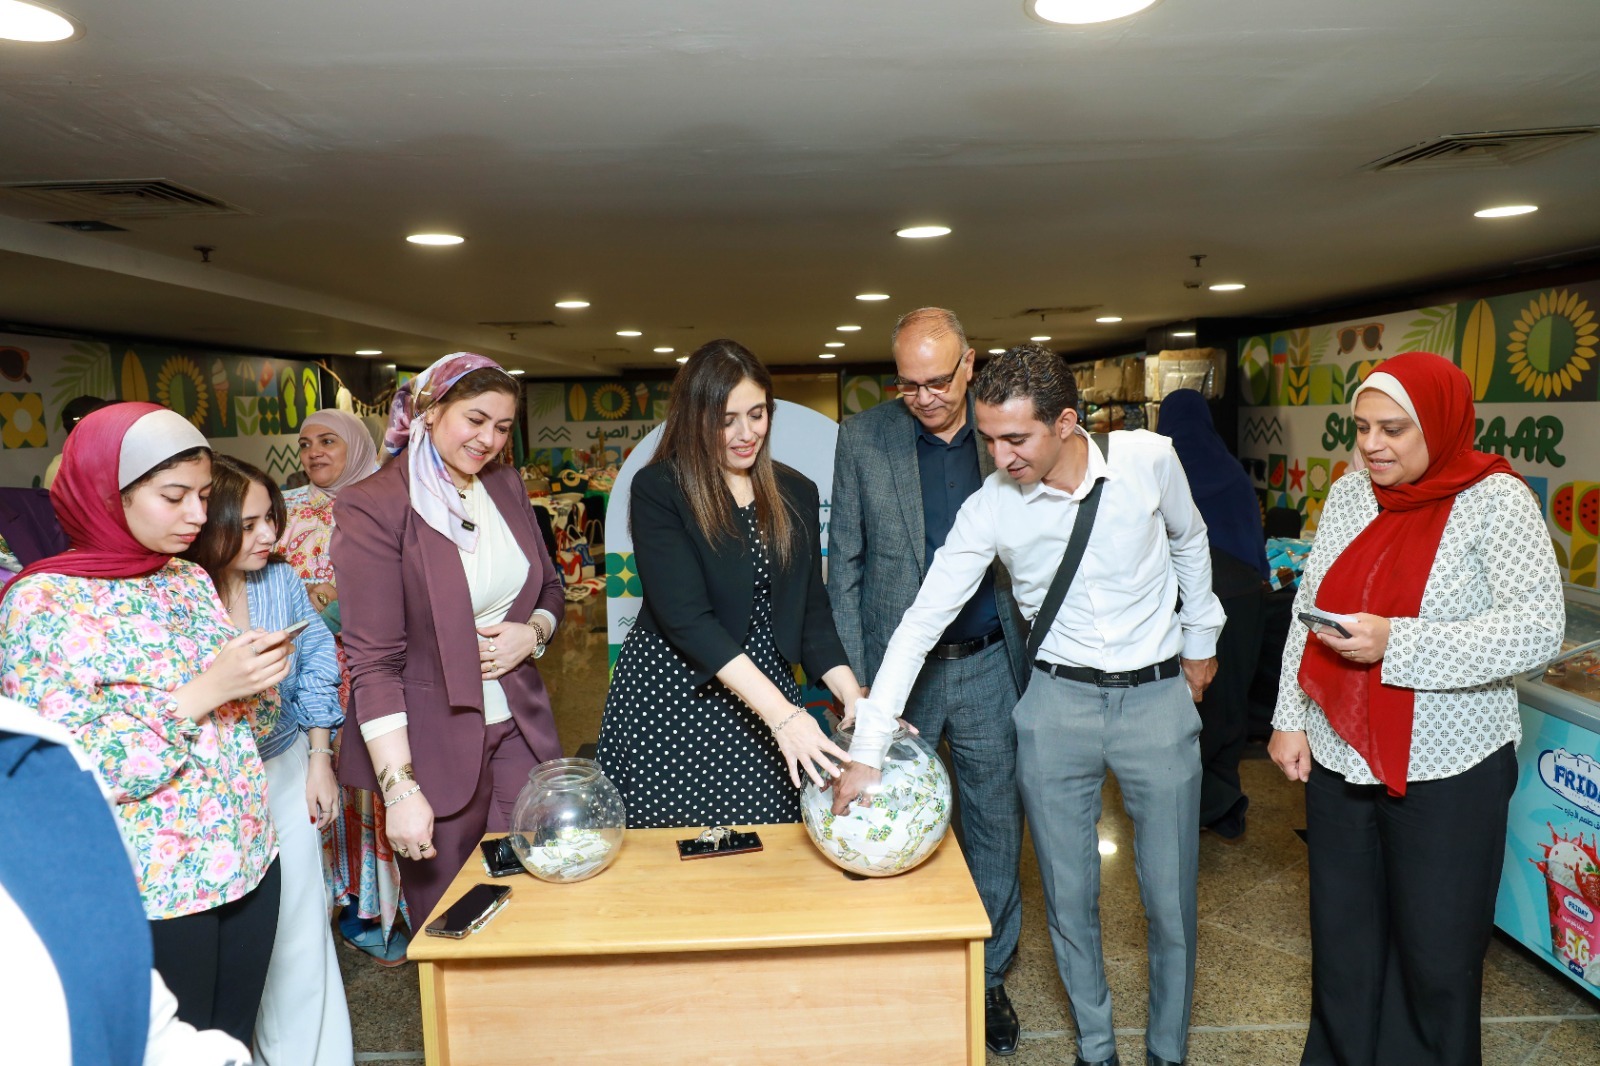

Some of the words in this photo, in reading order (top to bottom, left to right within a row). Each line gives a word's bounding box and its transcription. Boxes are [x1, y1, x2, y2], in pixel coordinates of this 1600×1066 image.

[586, 425, 629, 441] الصيف
[1554, 764, 1600, 803] FRID
[1567, 900, 1588, 918] FRIDAY
